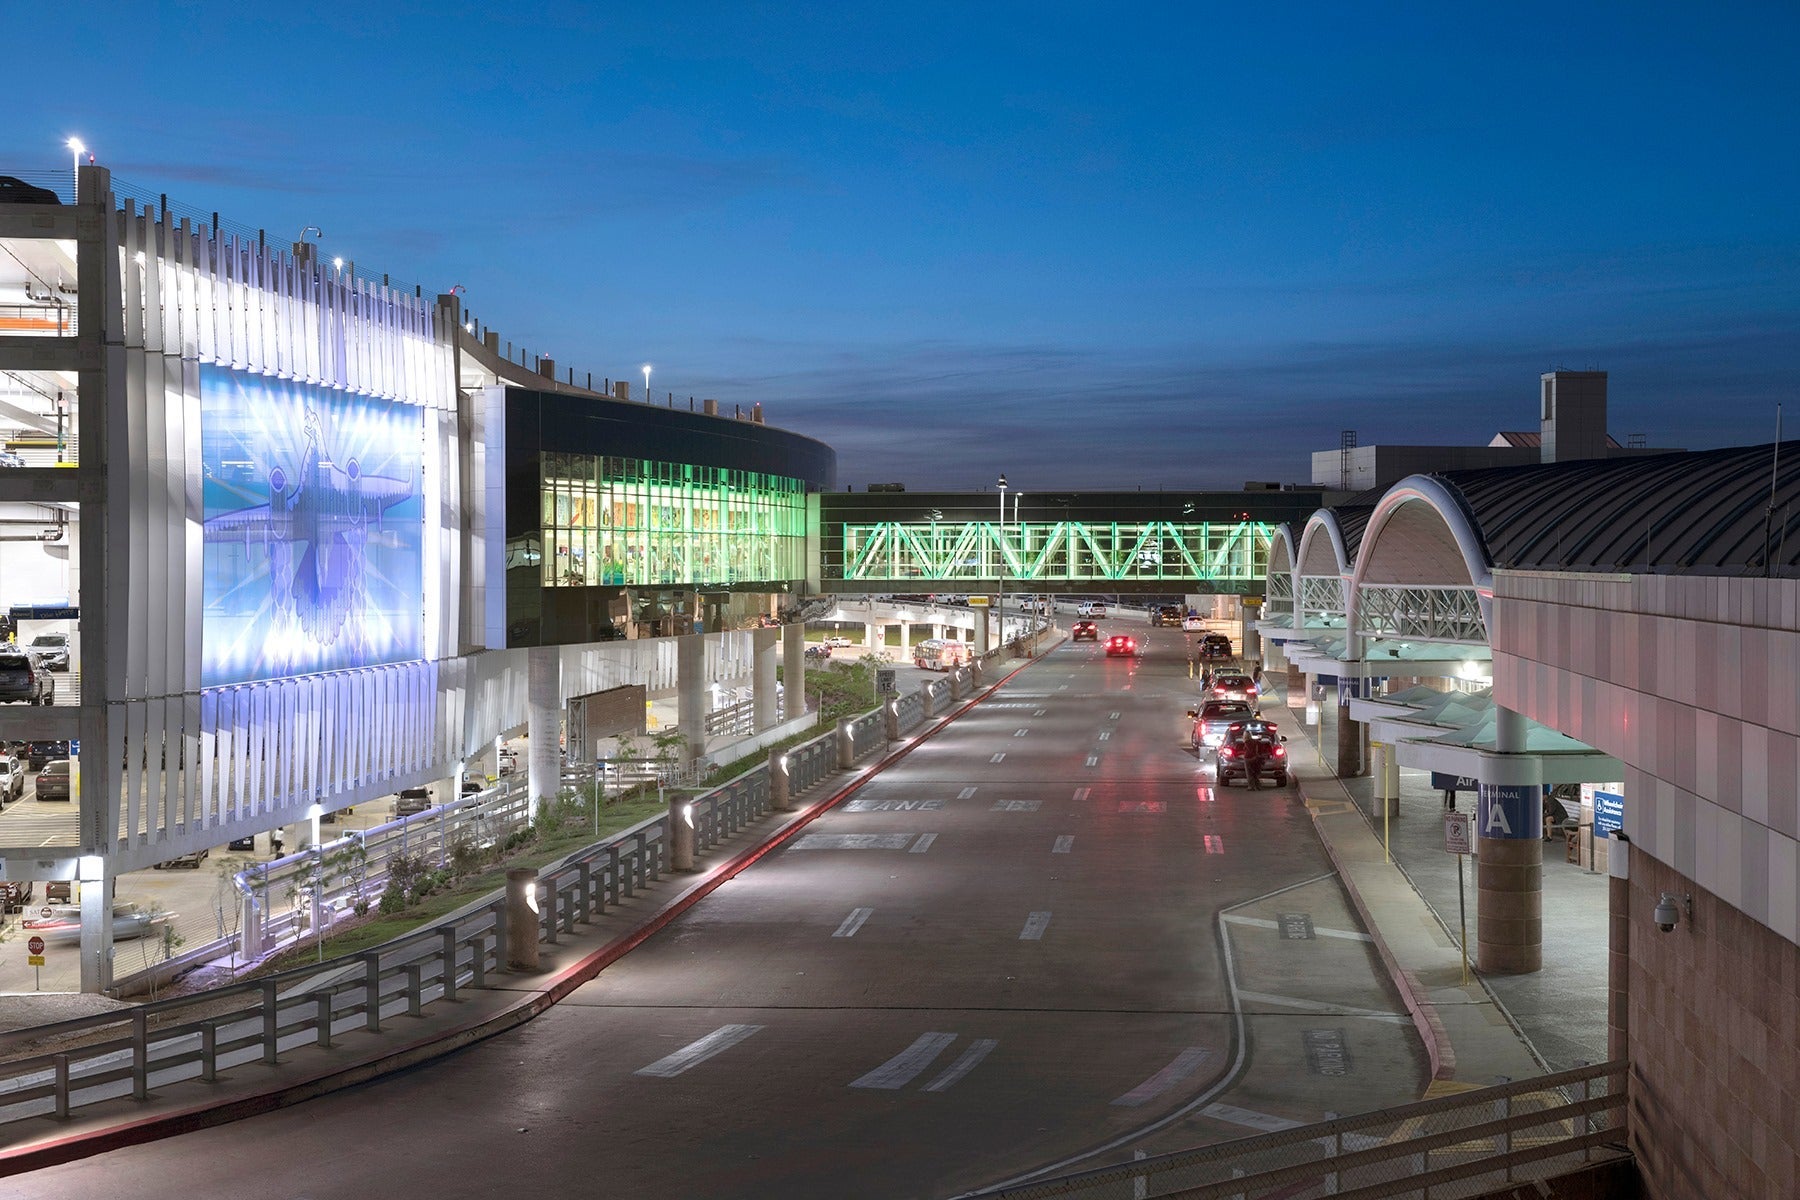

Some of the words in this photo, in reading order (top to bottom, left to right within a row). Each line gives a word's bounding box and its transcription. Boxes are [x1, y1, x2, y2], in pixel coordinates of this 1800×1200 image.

[882, 682, 891, 691] 15
[1486, 804, 1512, 834] A
[29, 941, 44, 950] STOP
